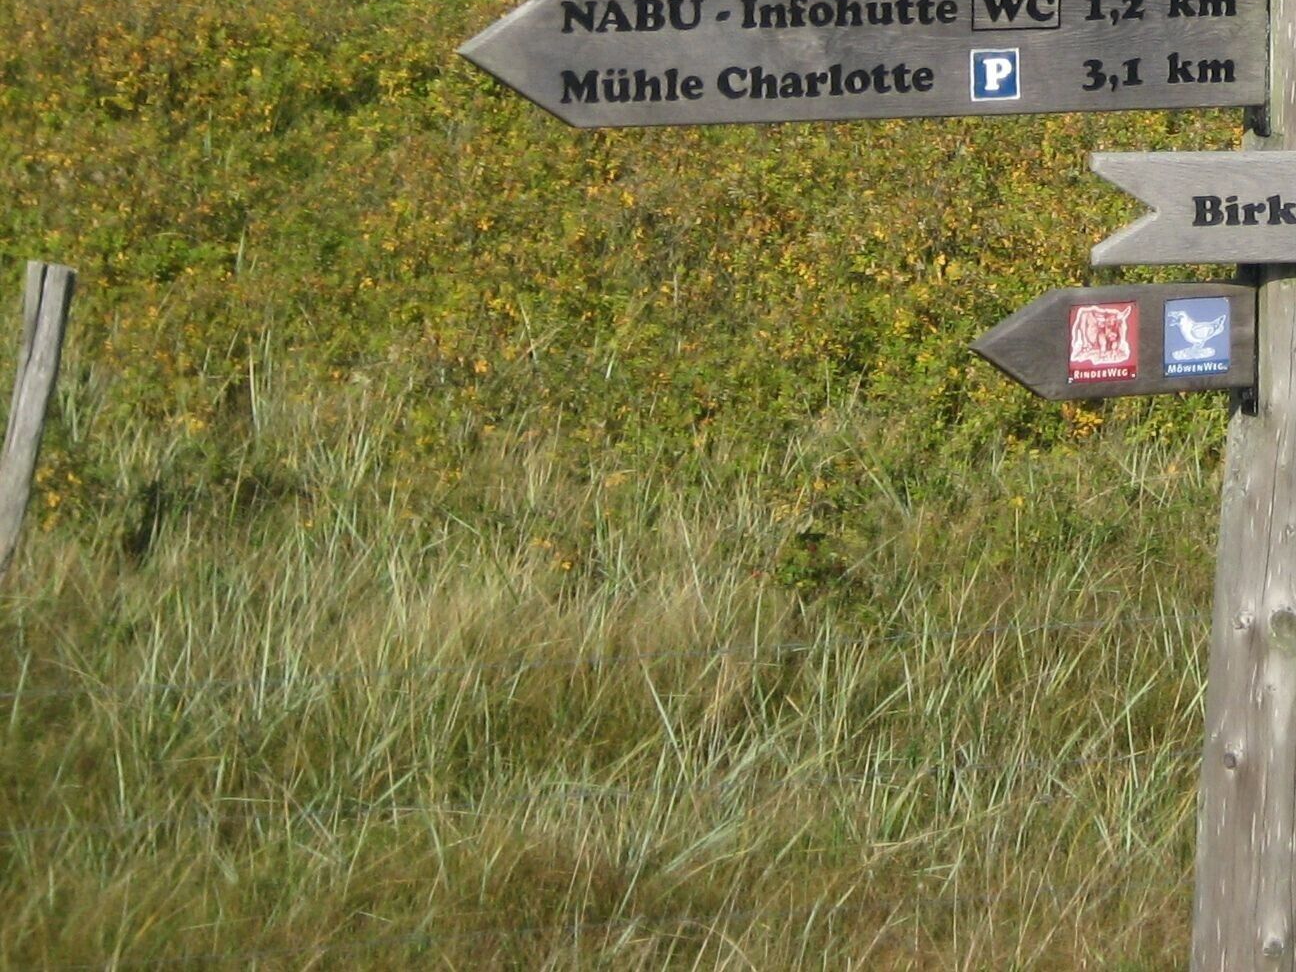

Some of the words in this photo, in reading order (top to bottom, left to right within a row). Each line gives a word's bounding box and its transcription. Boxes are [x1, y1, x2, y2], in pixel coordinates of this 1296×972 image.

[560, 68, 704, 104] Mühle
[717, 63, 934, 99] Charlotte
[982, 58, 1013, 91] P
[1082, 58, 1143, 92] 3,1
[1167, 52, 1236, 83] km
